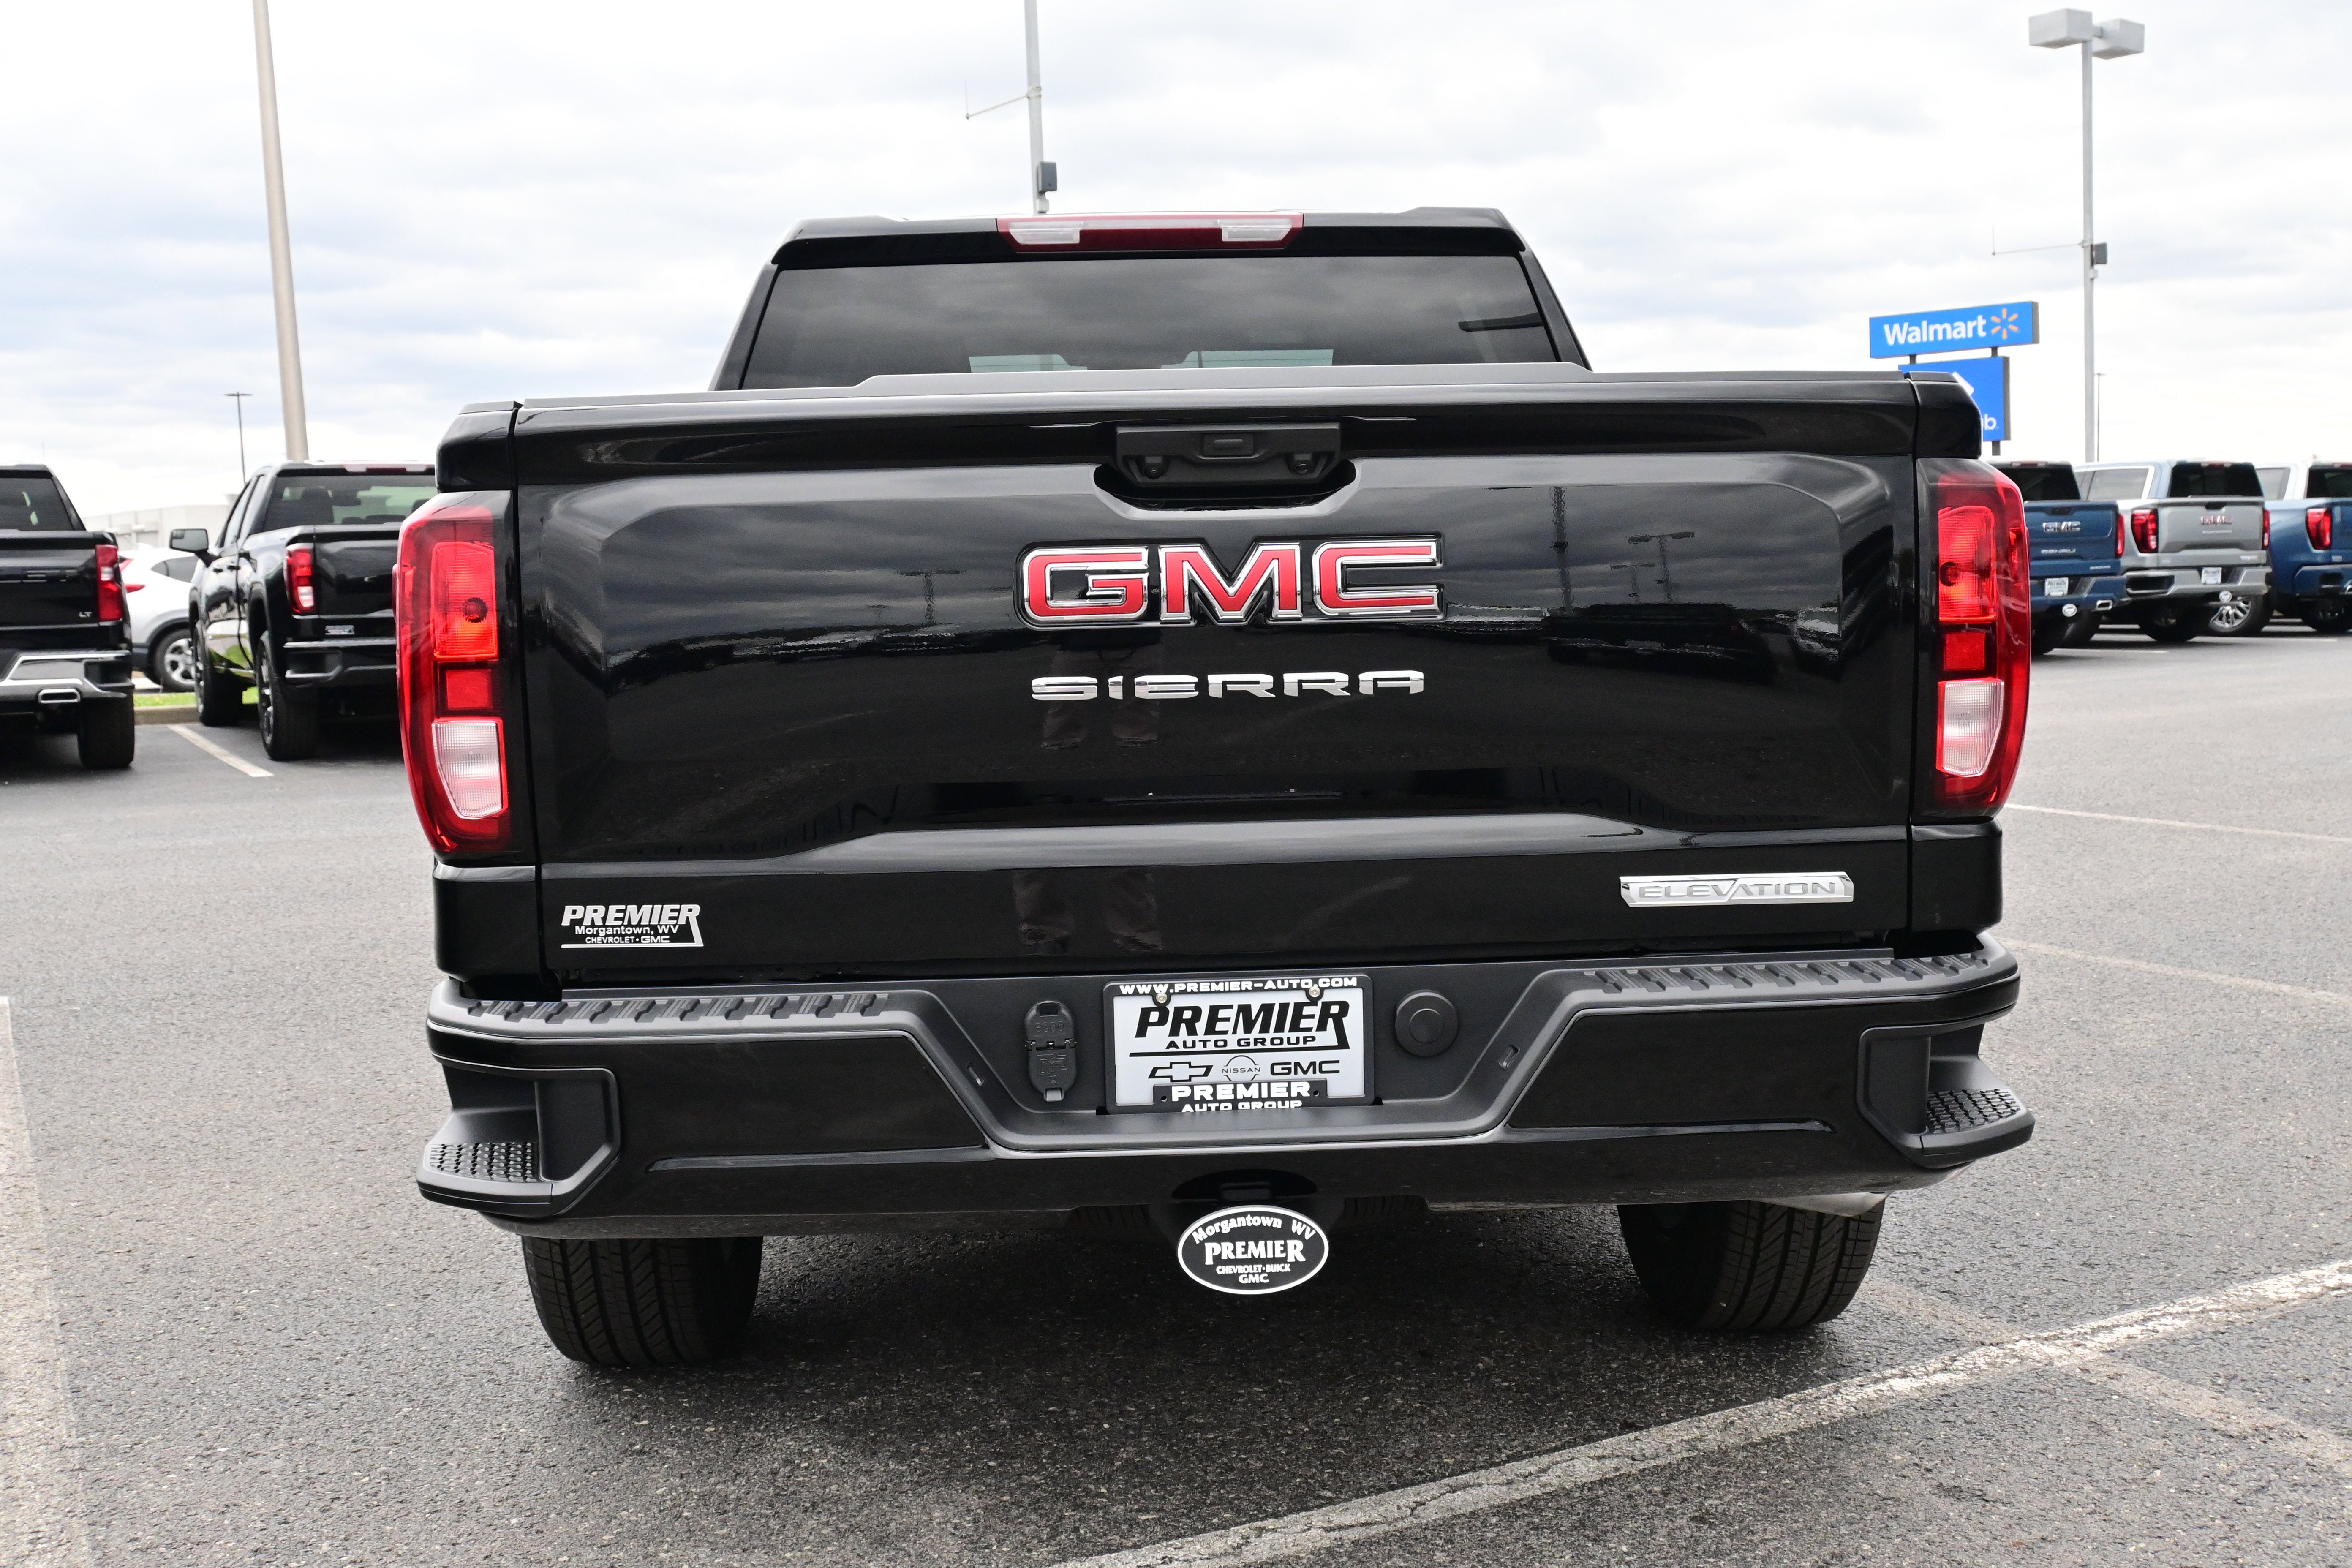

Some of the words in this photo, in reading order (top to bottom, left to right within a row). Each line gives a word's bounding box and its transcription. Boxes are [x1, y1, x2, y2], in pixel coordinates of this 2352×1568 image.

[1884, 315, 1987, 346] Walmart
[1021, 539, 1444, 626] GMC
[1031, 670, 1424, 701] SIERRA
[1639, 882, 1836, 900] ELEVATION
[561, 904, 702, 932] PREMIER
[575, 925, 654, 936] Morgantown,
[657, 925, 679, 934] WV
[1119, 977, 1358, 995] WWW.PREMIER-AUTO.COM
[1134, 1000, 1350, 1048] PREMIER
[1165, 1039, 1227, 1050] AUTO
[1236, 1035, 1316, 1048] GROUP
[1222, 1066, 1261, 1074] NISSAN
[1270, 1059, 1340, 1076] GMC
[1171, 1081, 1311, 1102] PREMIER
[1181, 1102, 1233, 1113] AUTO
[1237, 1100, 1302, 1110] GROUP
[1191, 1214, 1282, 1244] Morgantown
[1291, 1219, 1317, 1241] WV
[1204, 1239, 1306, 1265] PREMIER
[1239, 1273, 1269, 1284] GMC
